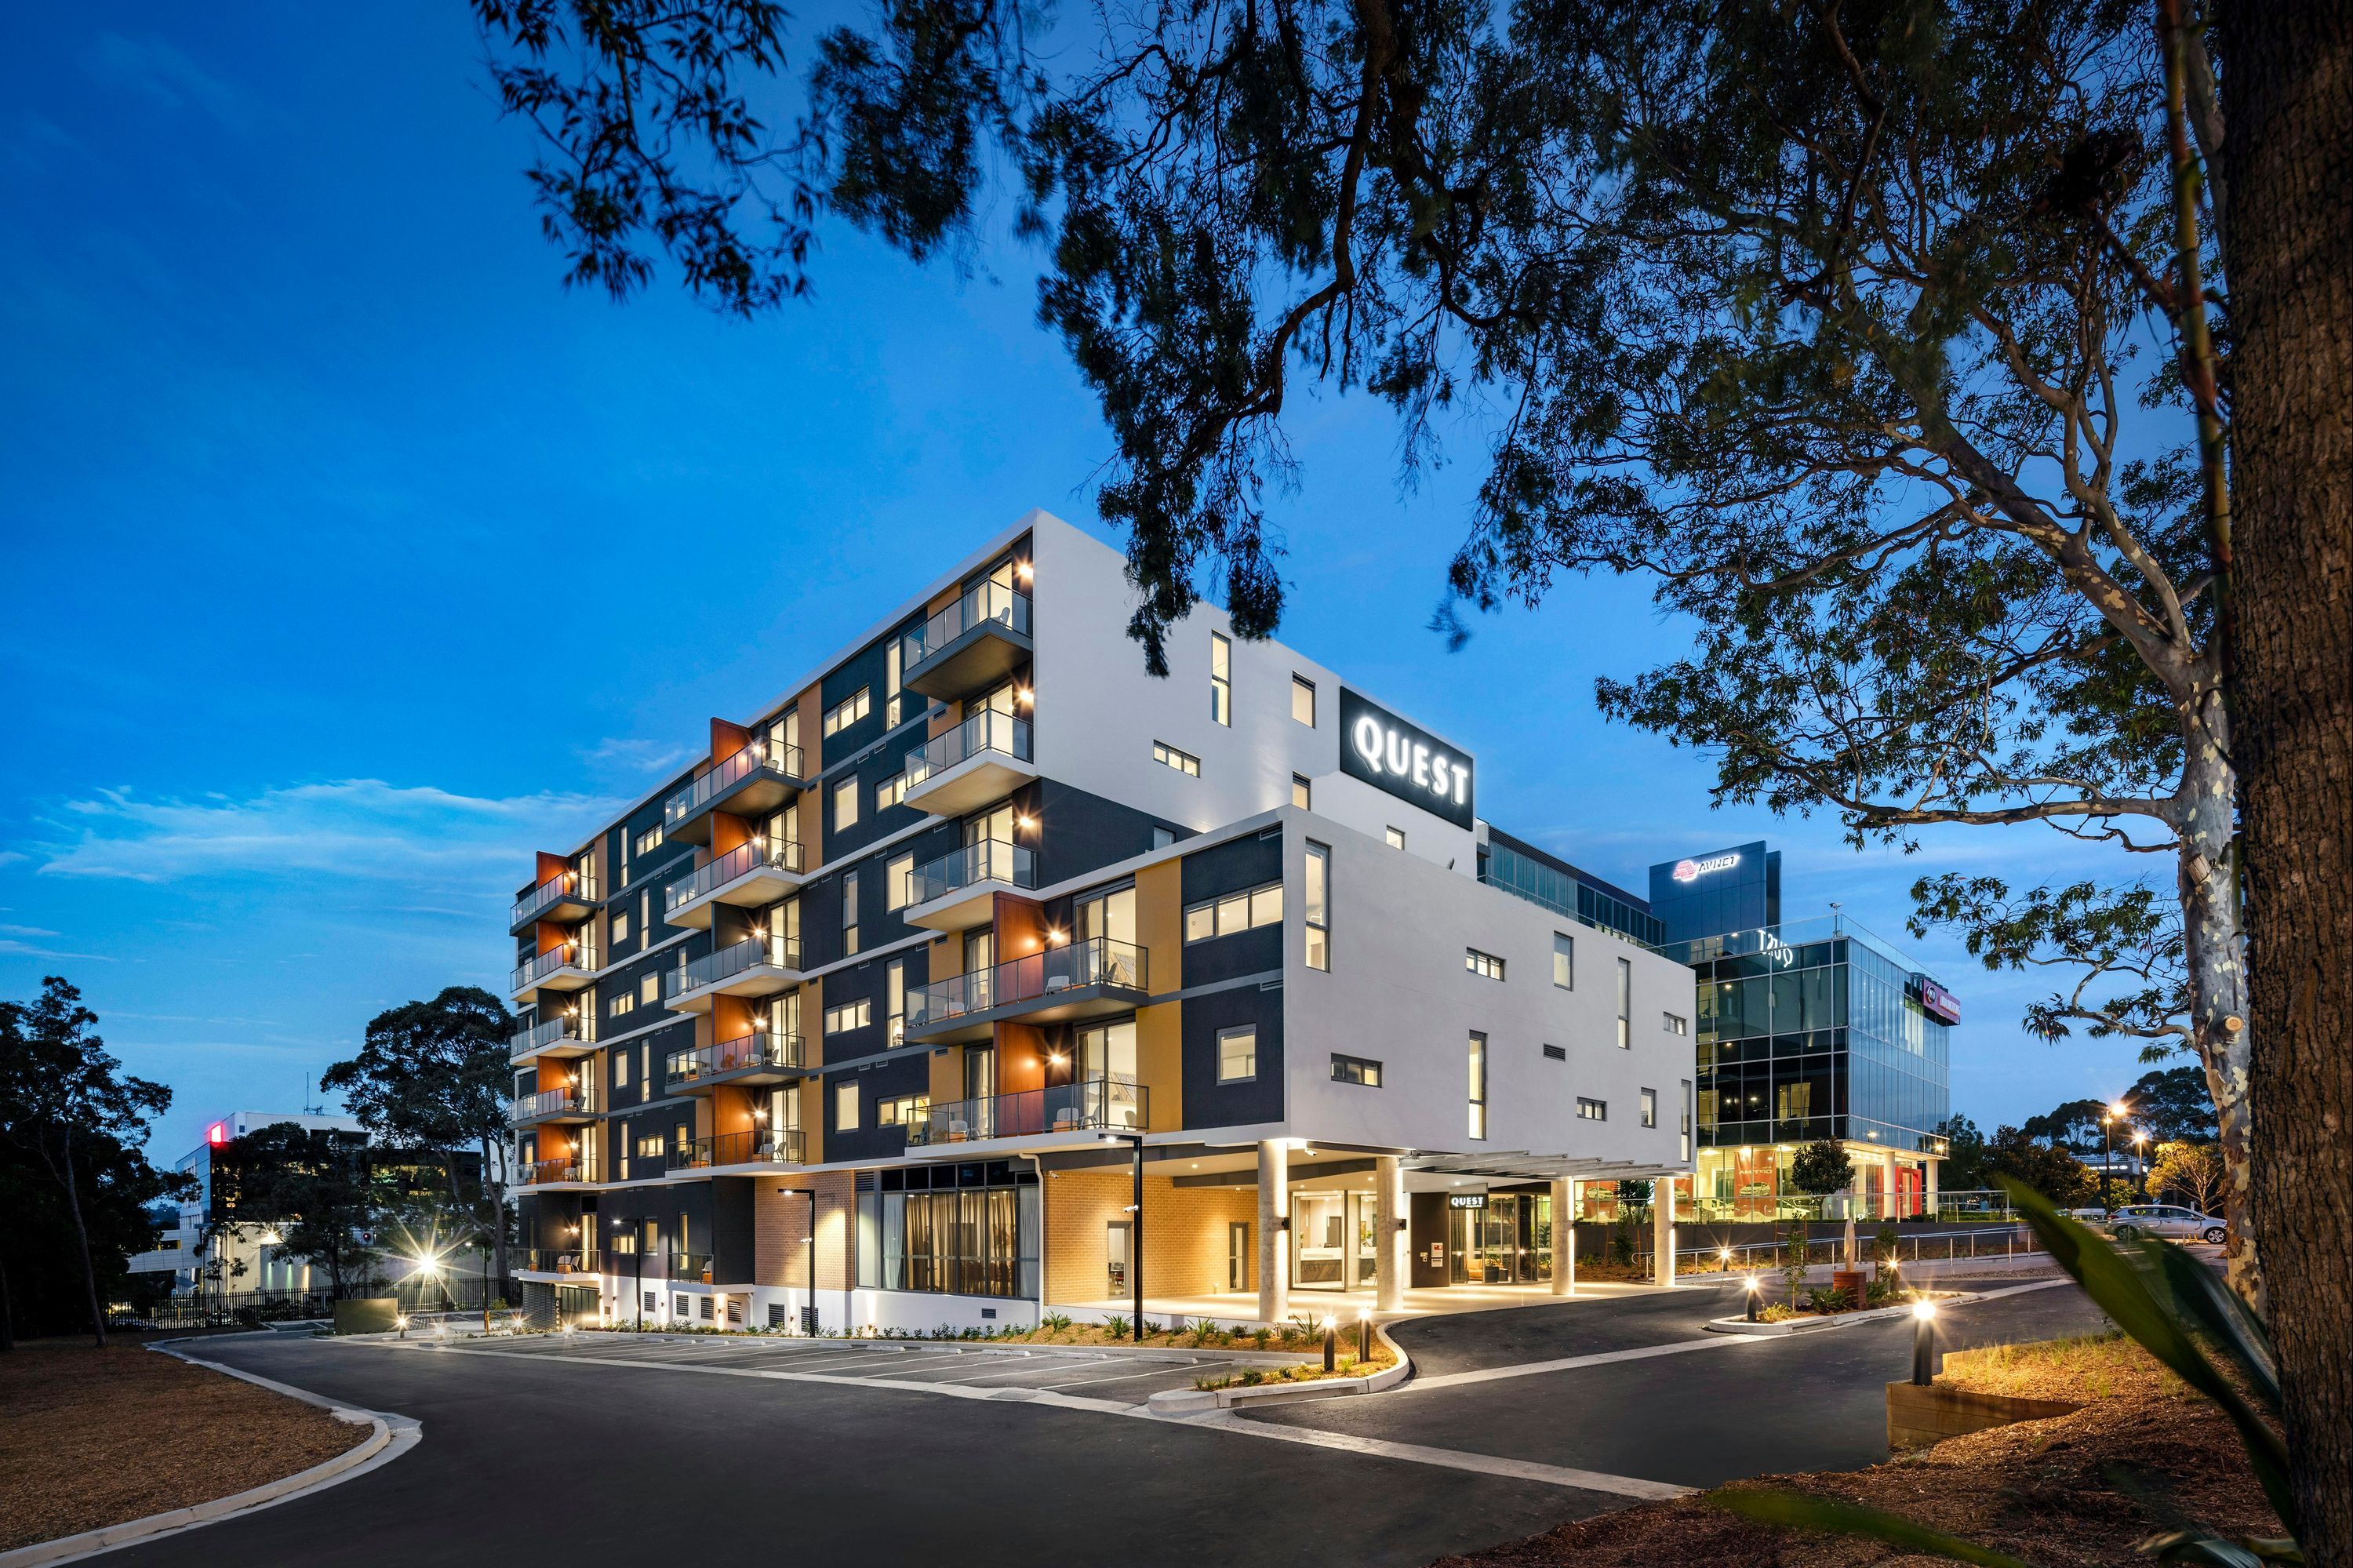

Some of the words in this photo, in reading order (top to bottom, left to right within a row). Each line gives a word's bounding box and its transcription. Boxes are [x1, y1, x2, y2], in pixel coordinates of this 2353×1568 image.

[1352, 717, 1467, 804] QUEST
[1697, 855, 1736, 872] AVNET
[1451, 1196, 1483, 1207] QUEST
